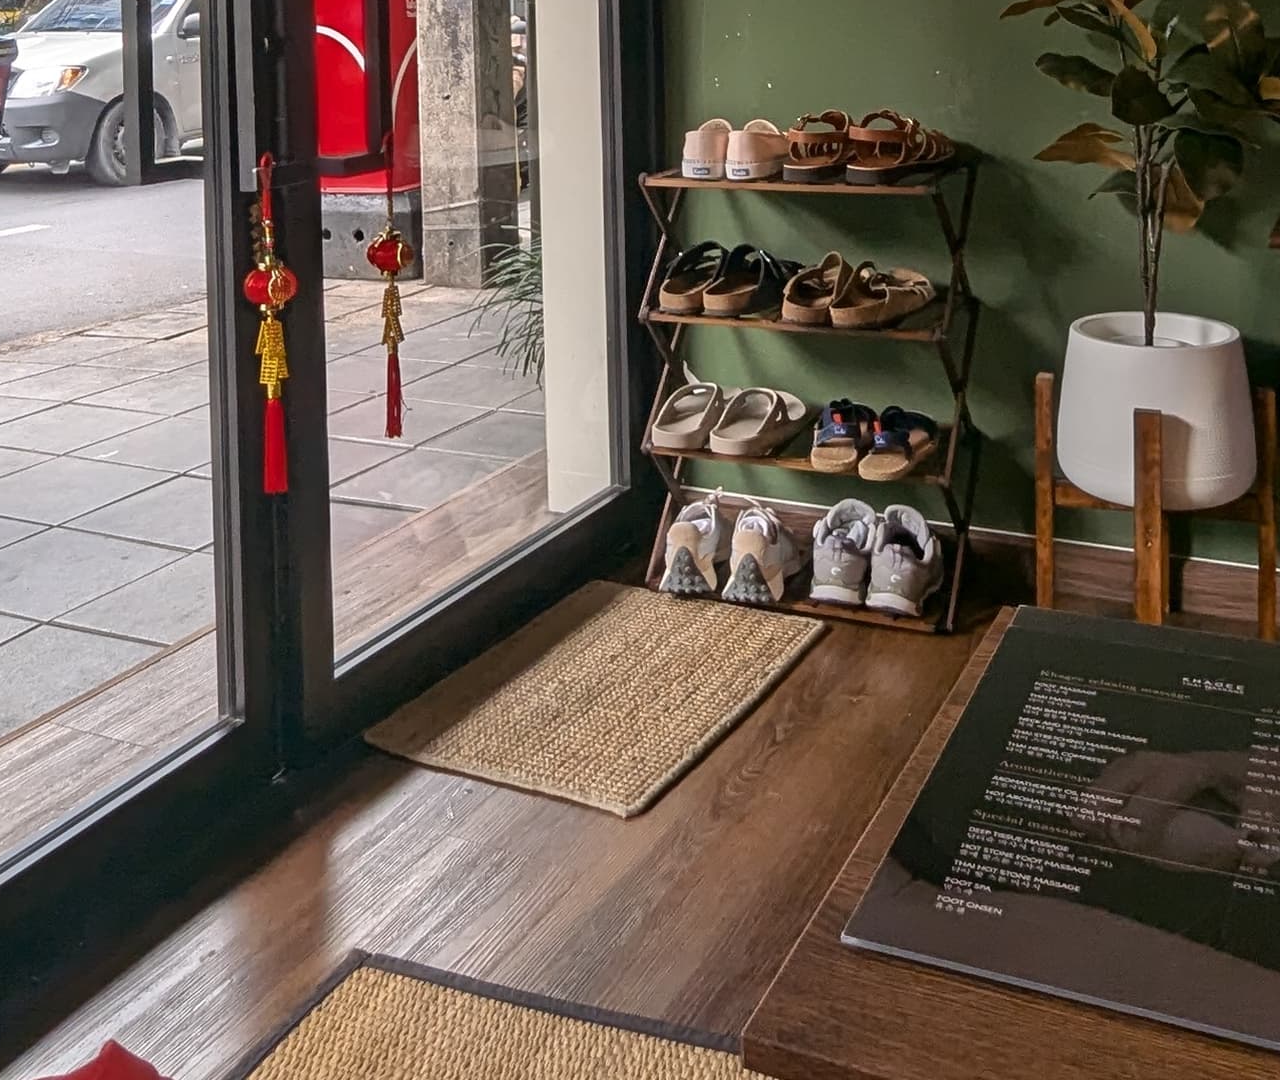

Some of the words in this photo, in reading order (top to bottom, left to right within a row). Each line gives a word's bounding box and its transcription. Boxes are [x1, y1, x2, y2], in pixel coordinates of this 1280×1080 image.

[945, 876, 973, 889] FOOT
[974, 883, 992, 893] SPA
[936, 895, 965, 907] FOOT
[966, 901, 1003, 915] ONSEN
